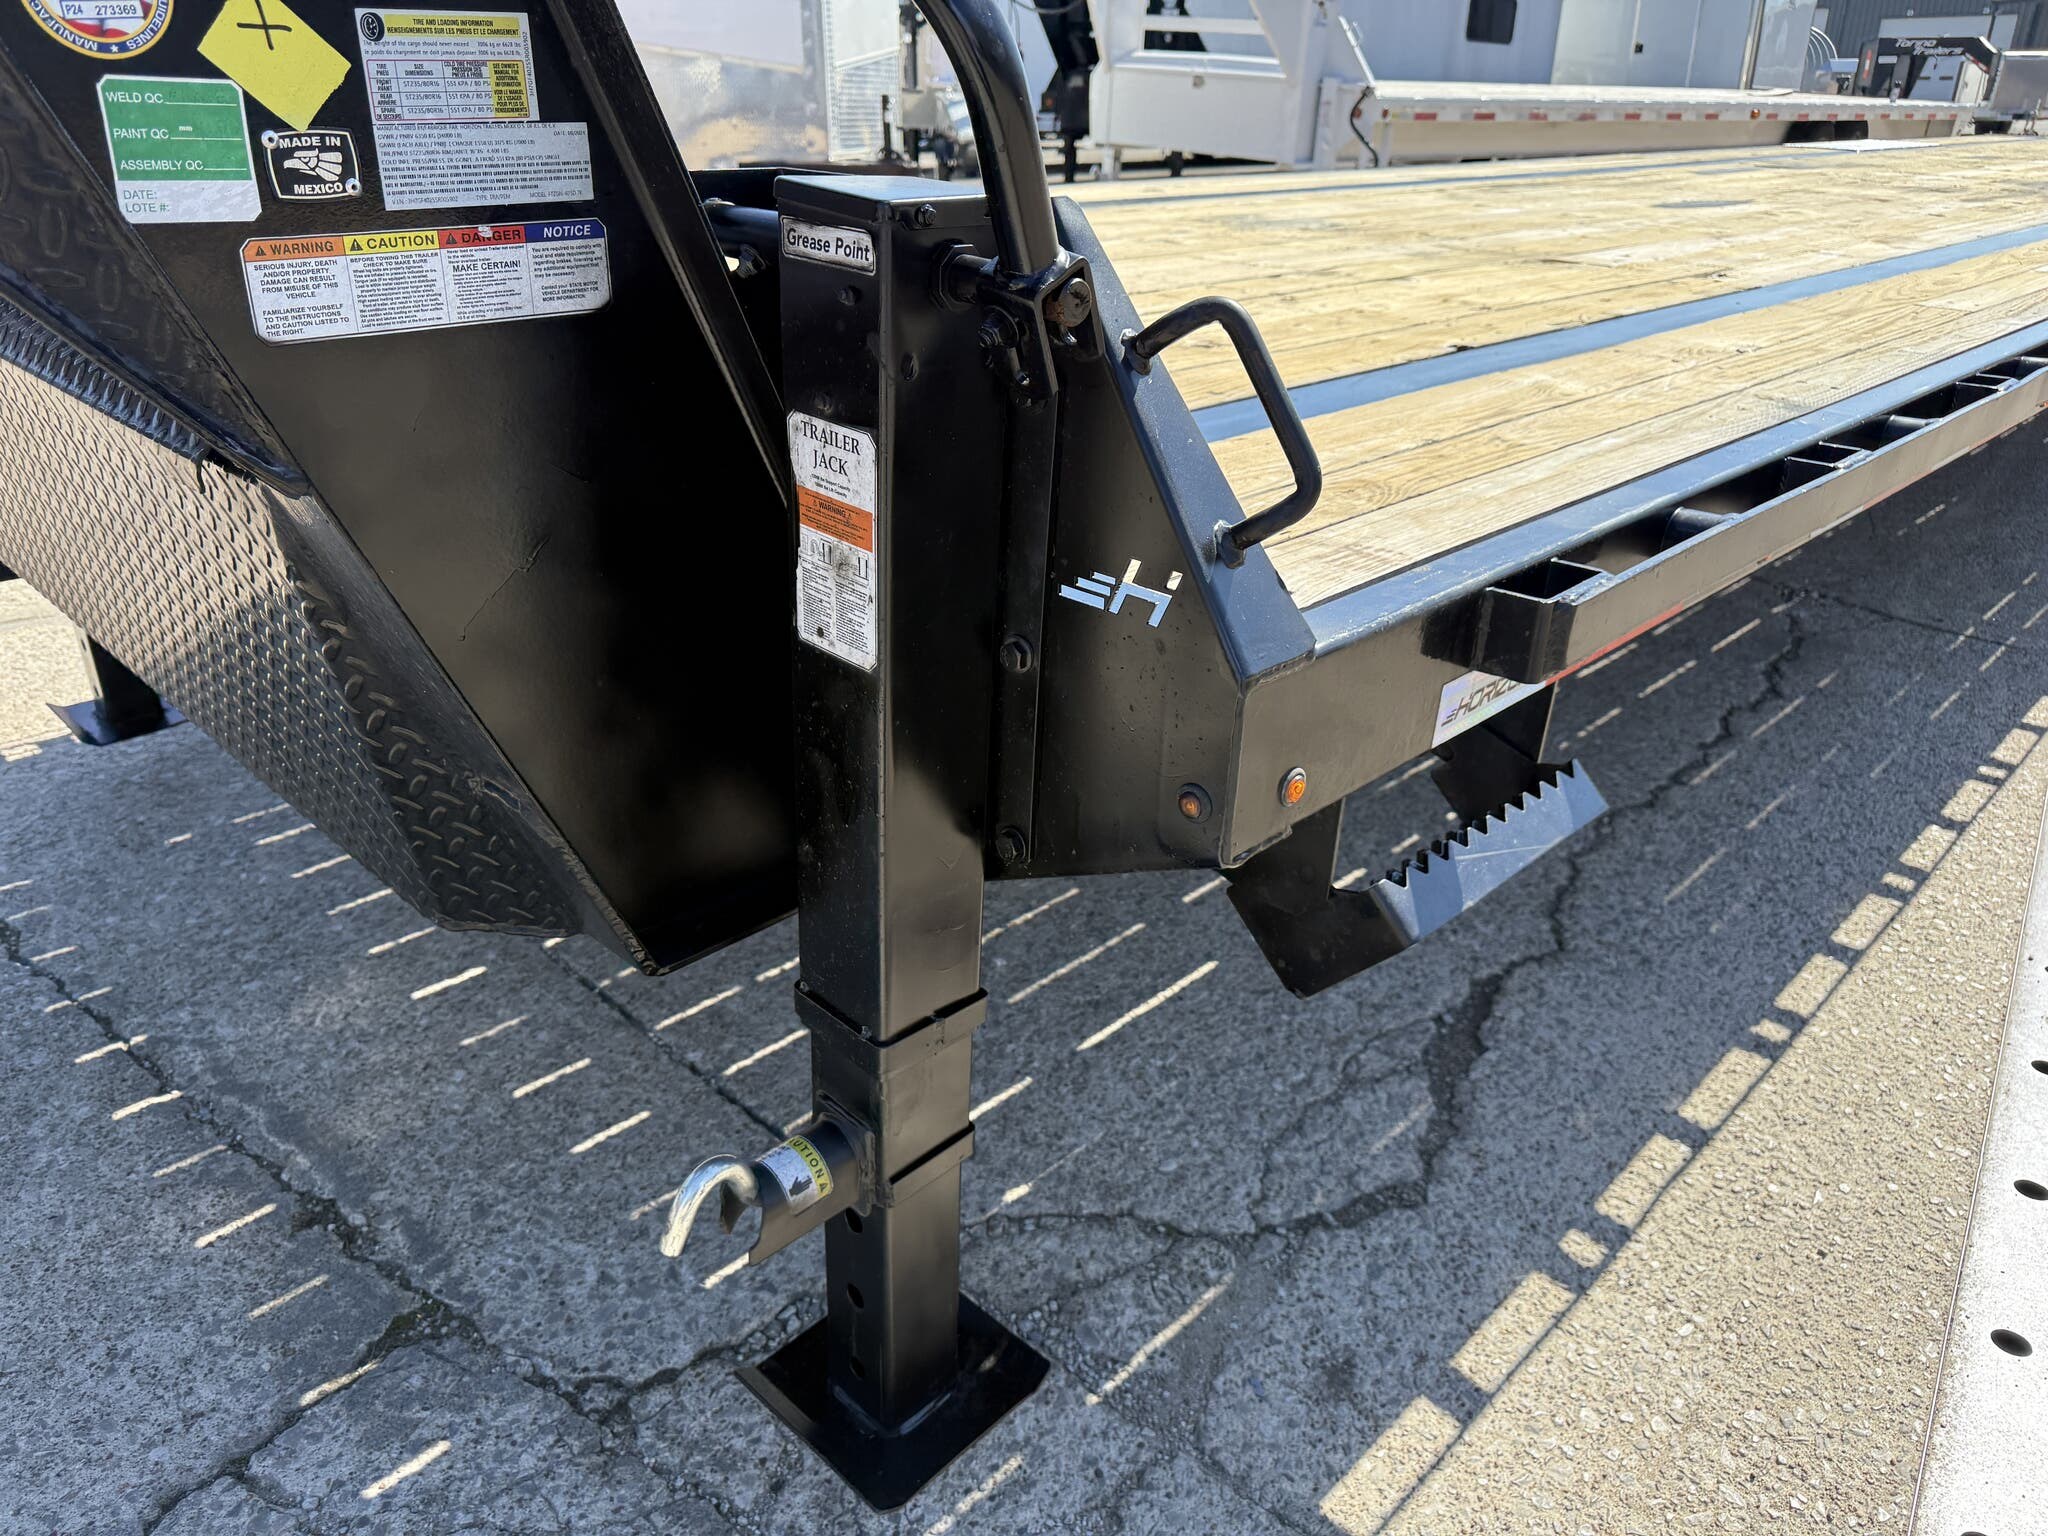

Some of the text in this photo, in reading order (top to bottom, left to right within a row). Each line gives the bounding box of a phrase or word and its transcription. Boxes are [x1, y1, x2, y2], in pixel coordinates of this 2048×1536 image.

[95, 5, 137, 16] 273369
[28, 0, 98, 51] MANUFAC
[126, 0, 169, 50] UIDELINES
[106, 92, 164, 104] WELD QC
[113, 128, 169, 140] PAINT QC
[280, 136, 341, 149] MADE IN
[120, 160, 204, 171] ASSEMBLY QC
[294, 182, 343, 195] MEXICO
[123, 190, 157, 200] DATE:
[126, 203, 156, 213] LOTE
[543, 225, 591, 238] NOTICE
[270, 240, 334, 256] WARNING
[367, 234, 435, 250] CAUTION
[787, 228, 870, 262] Grease Point
[254, 263, 286, 271] SERIOUS
[292, 268, 329, 276] PROPERTY
[452, 260, 521, 273] MAKE CERTAIN!
[260, 278, 292, 286] DAMAGE
[286, 291, 316, 299] VEHICLE
[263, 304, 344, 316] FAMILIARIZE YOURSELF
[291, 311, 341, 320] INSTRUCTIONS
[282, 320, 313, 329] CAUTION
[282, 328, 305, 336] RIGHT.
[800, 420, 860, 455] TRAILER
[813, 449, 849, 477] JACK
[819, 500, 847, 517] WARNING
[788, 1138, 824, 1178] UTION
